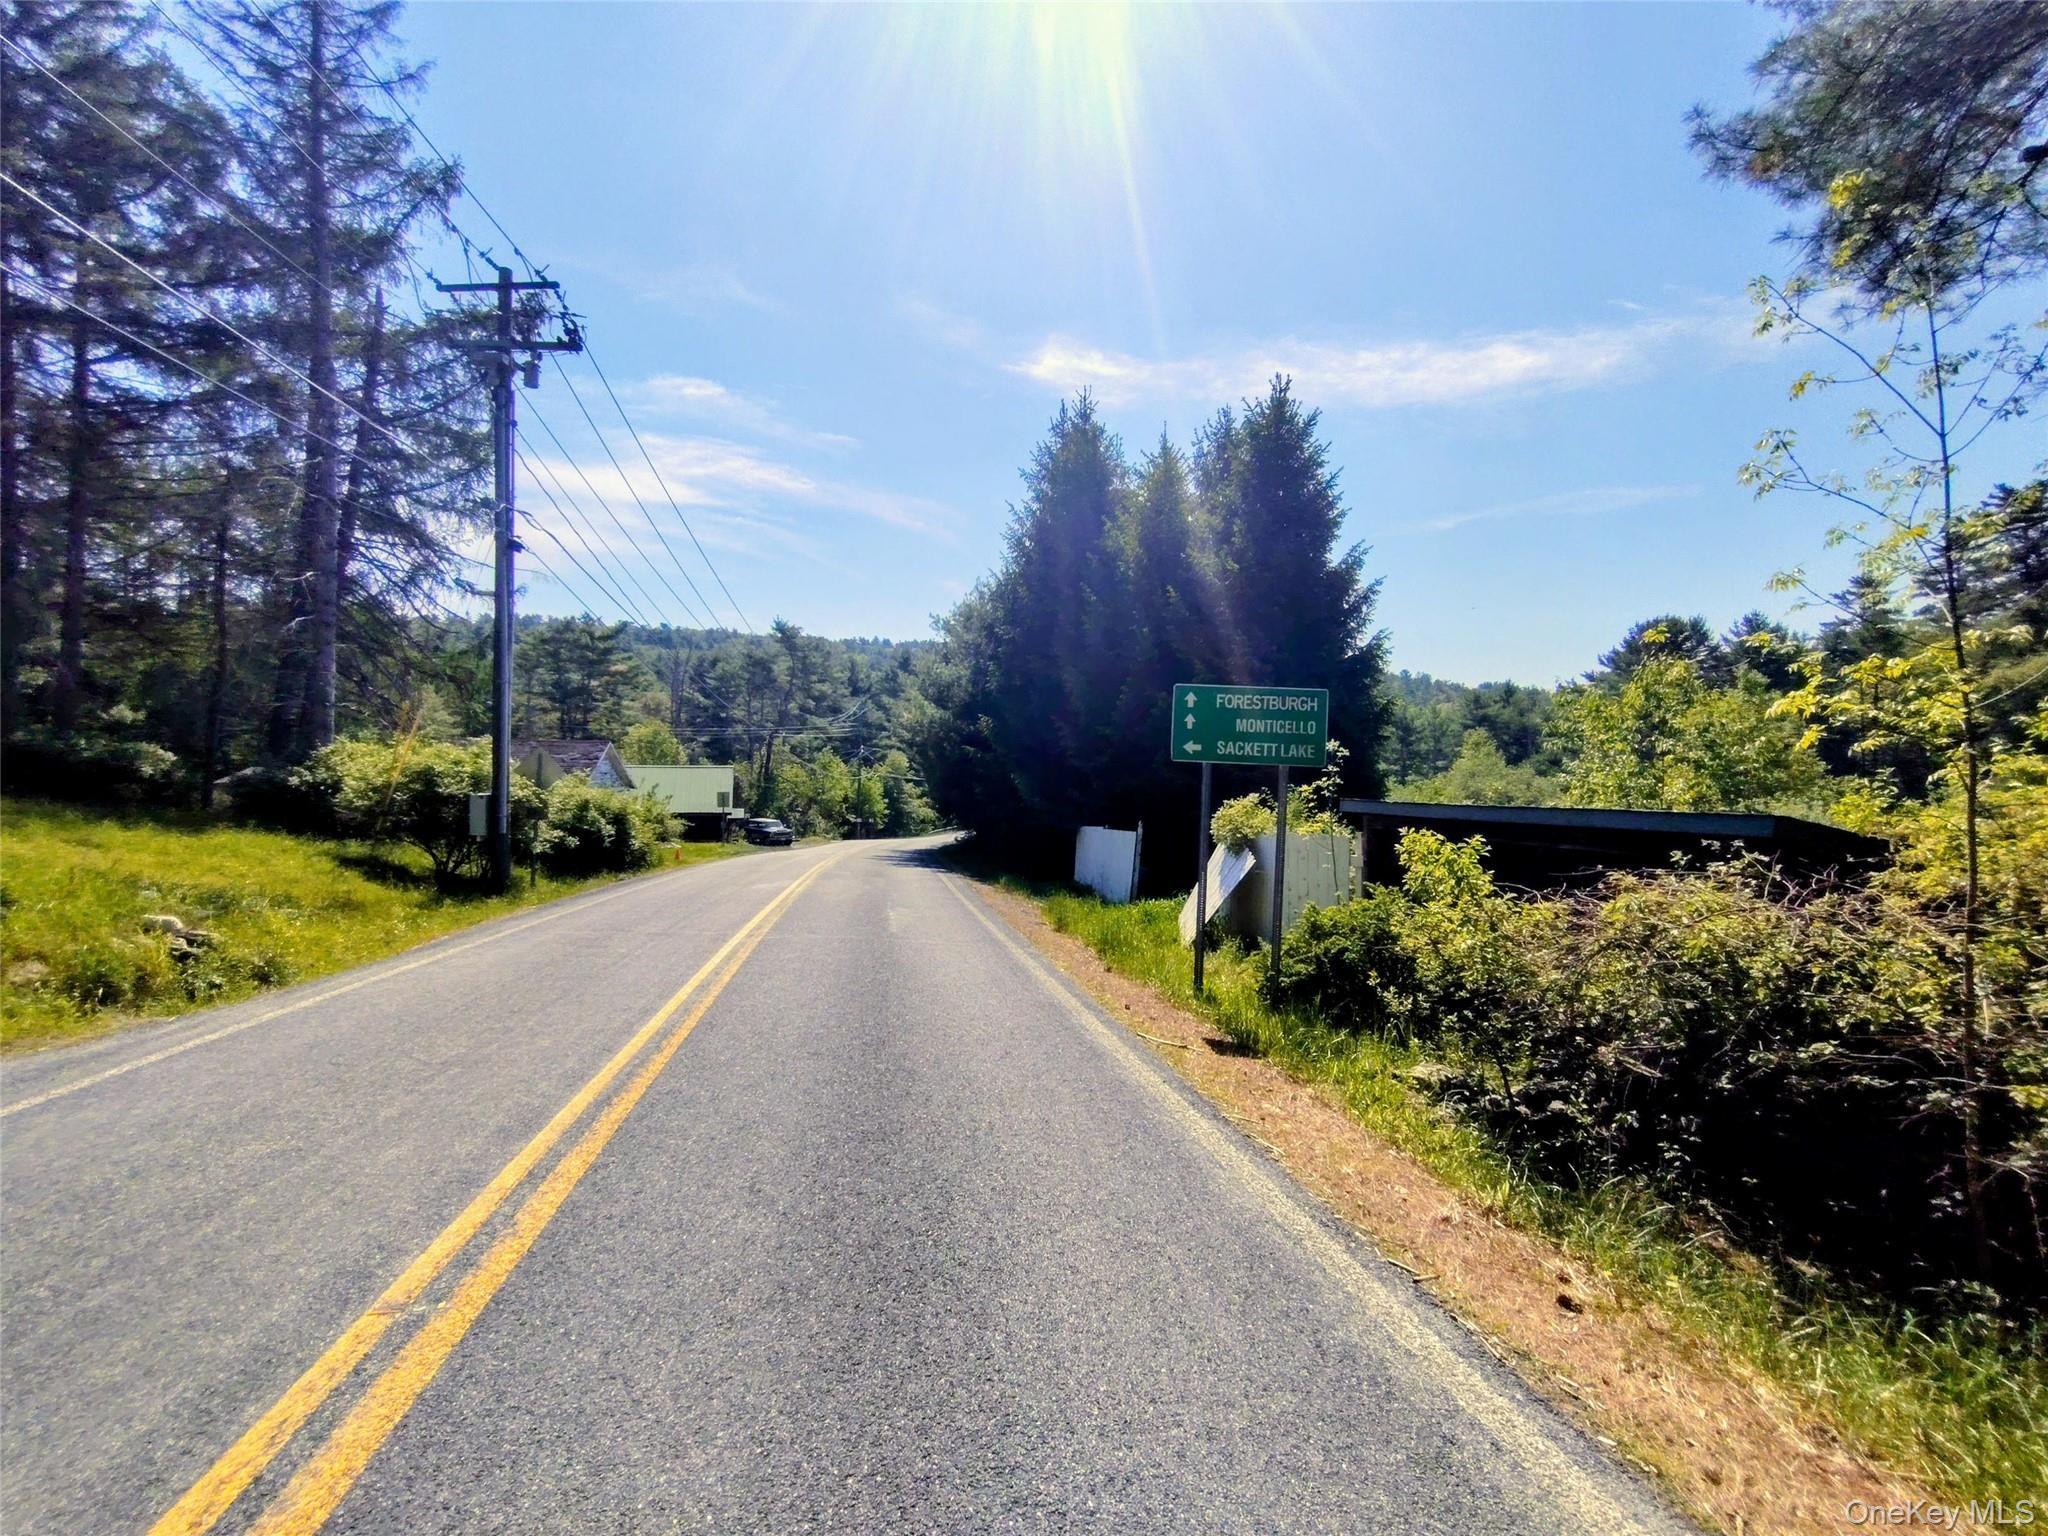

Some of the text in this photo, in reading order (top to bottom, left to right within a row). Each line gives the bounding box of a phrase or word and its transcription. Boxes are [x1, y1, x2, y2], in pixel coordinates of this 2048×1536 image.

[1216, 694, 1318, 711] FORESTBURGH
[1236, 718, 1316, 735] MONTICELLO
[1216, 740, 1315, 758] SACKETT LAKE
